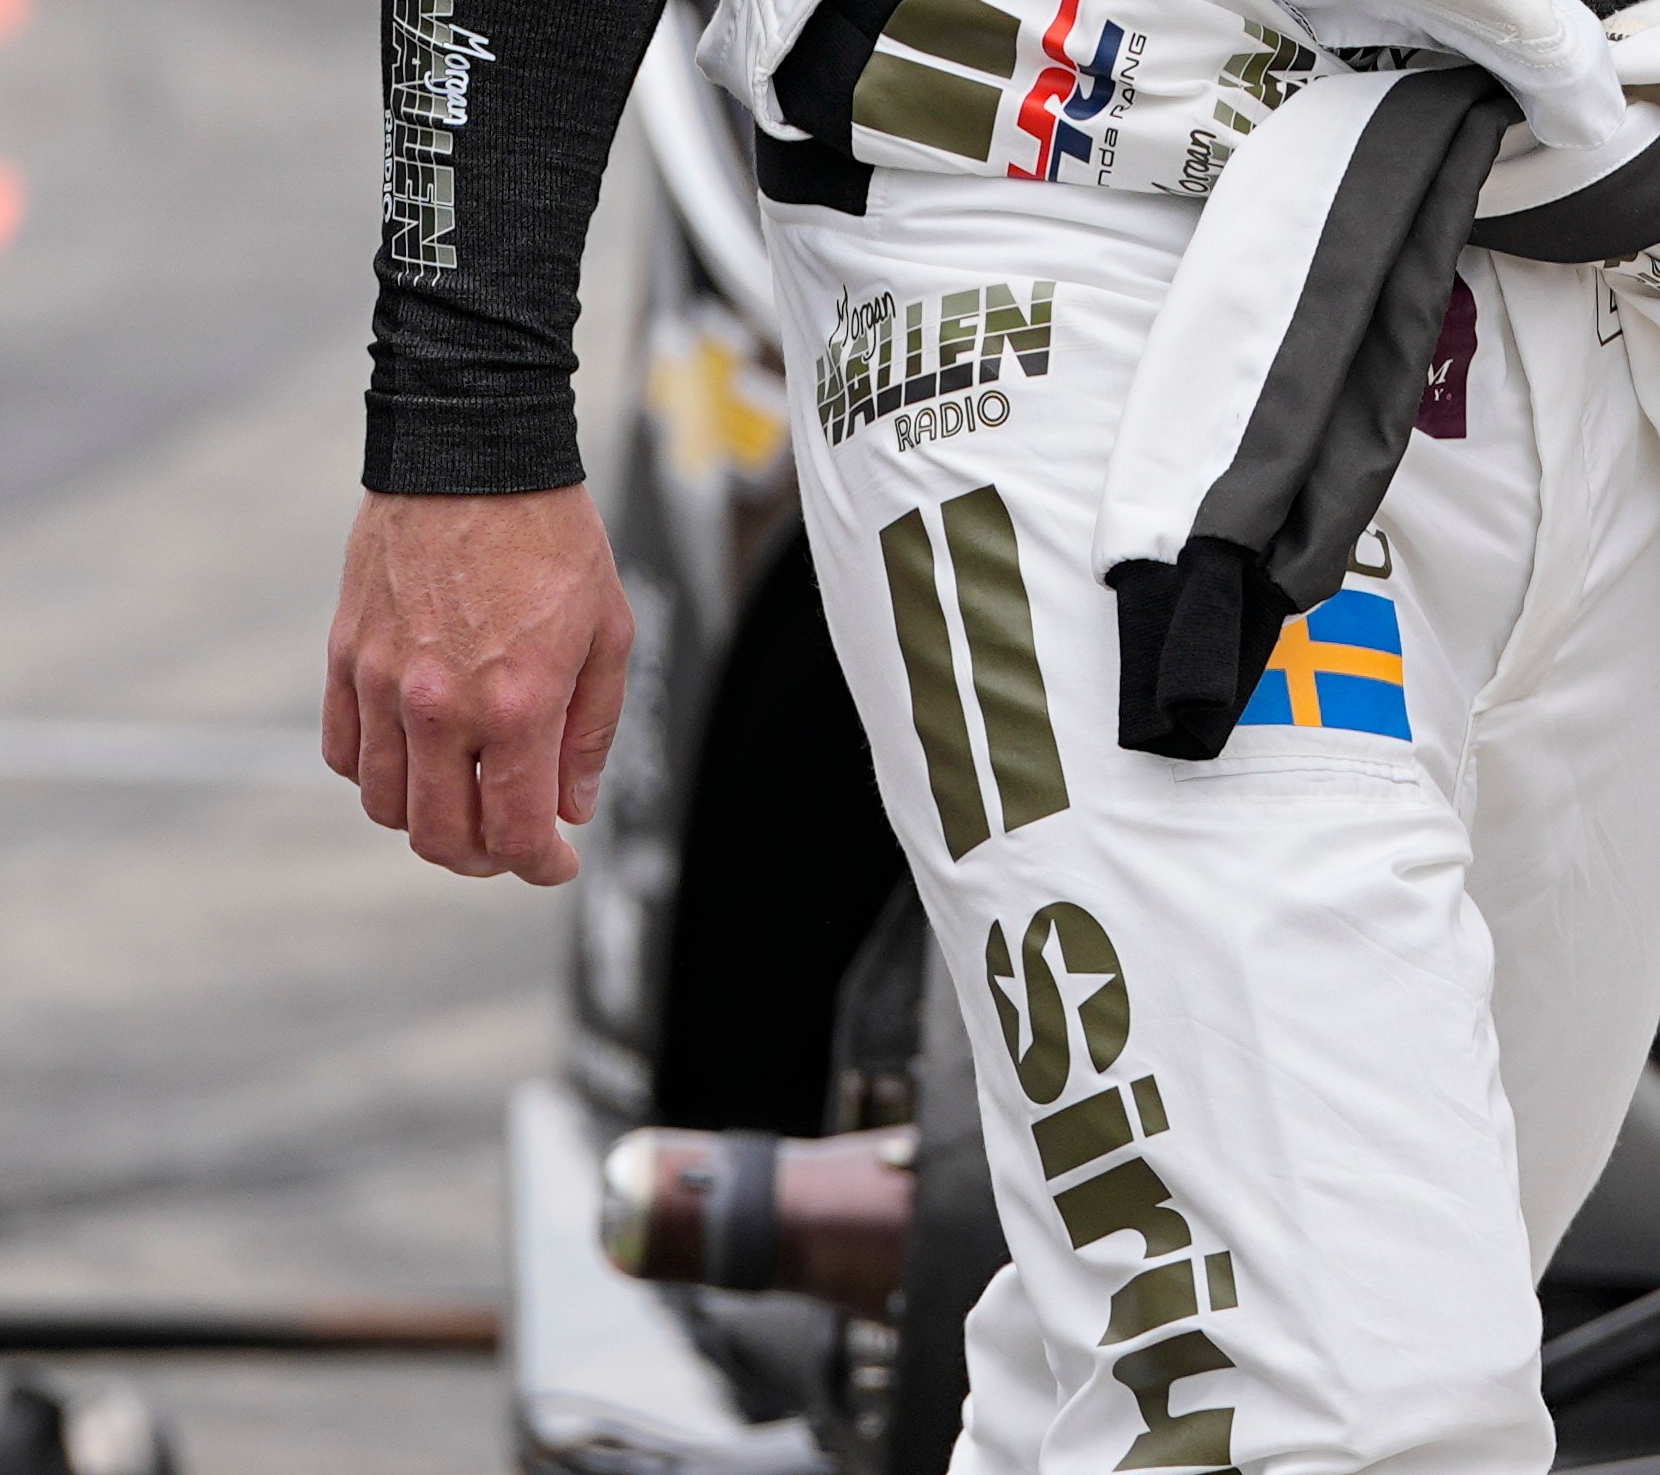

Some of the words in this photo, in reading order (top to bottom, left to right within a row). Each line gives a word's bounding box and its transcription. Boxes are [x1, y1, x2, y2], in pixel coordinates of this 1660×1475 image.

[424, 23, 496, 127] Morgan
[828, 284, 896, 363] Morgan
[893, 390, 1012, 453] RADIO
[985, 901, 1239, 1475] Siriu
